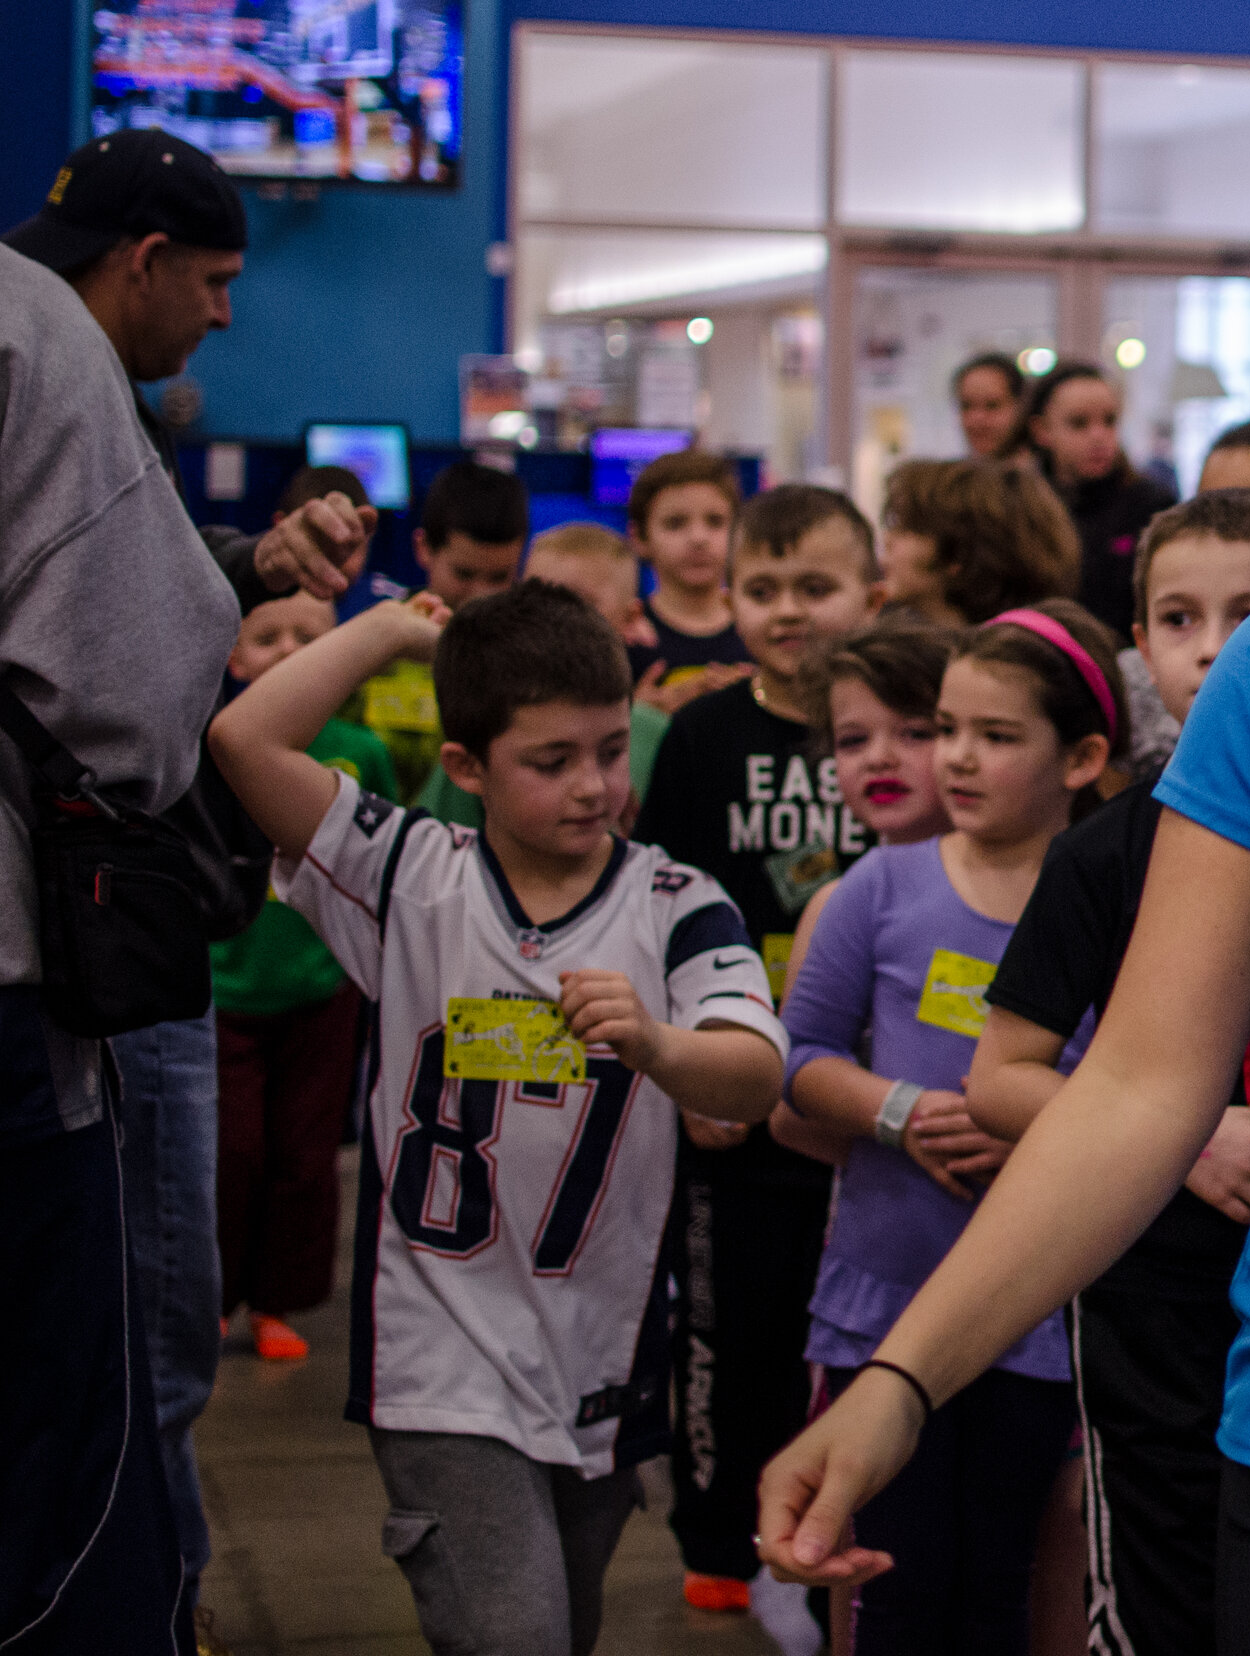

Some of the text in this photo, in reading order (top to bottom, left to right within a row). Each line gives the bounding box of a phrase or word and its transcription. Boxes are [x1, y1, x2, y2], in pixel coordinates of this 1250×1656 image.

[746, 754, 843, 804] EAS
[727, 801, 868, 854] MONE
[385, 1023, 644, 1278] 87
